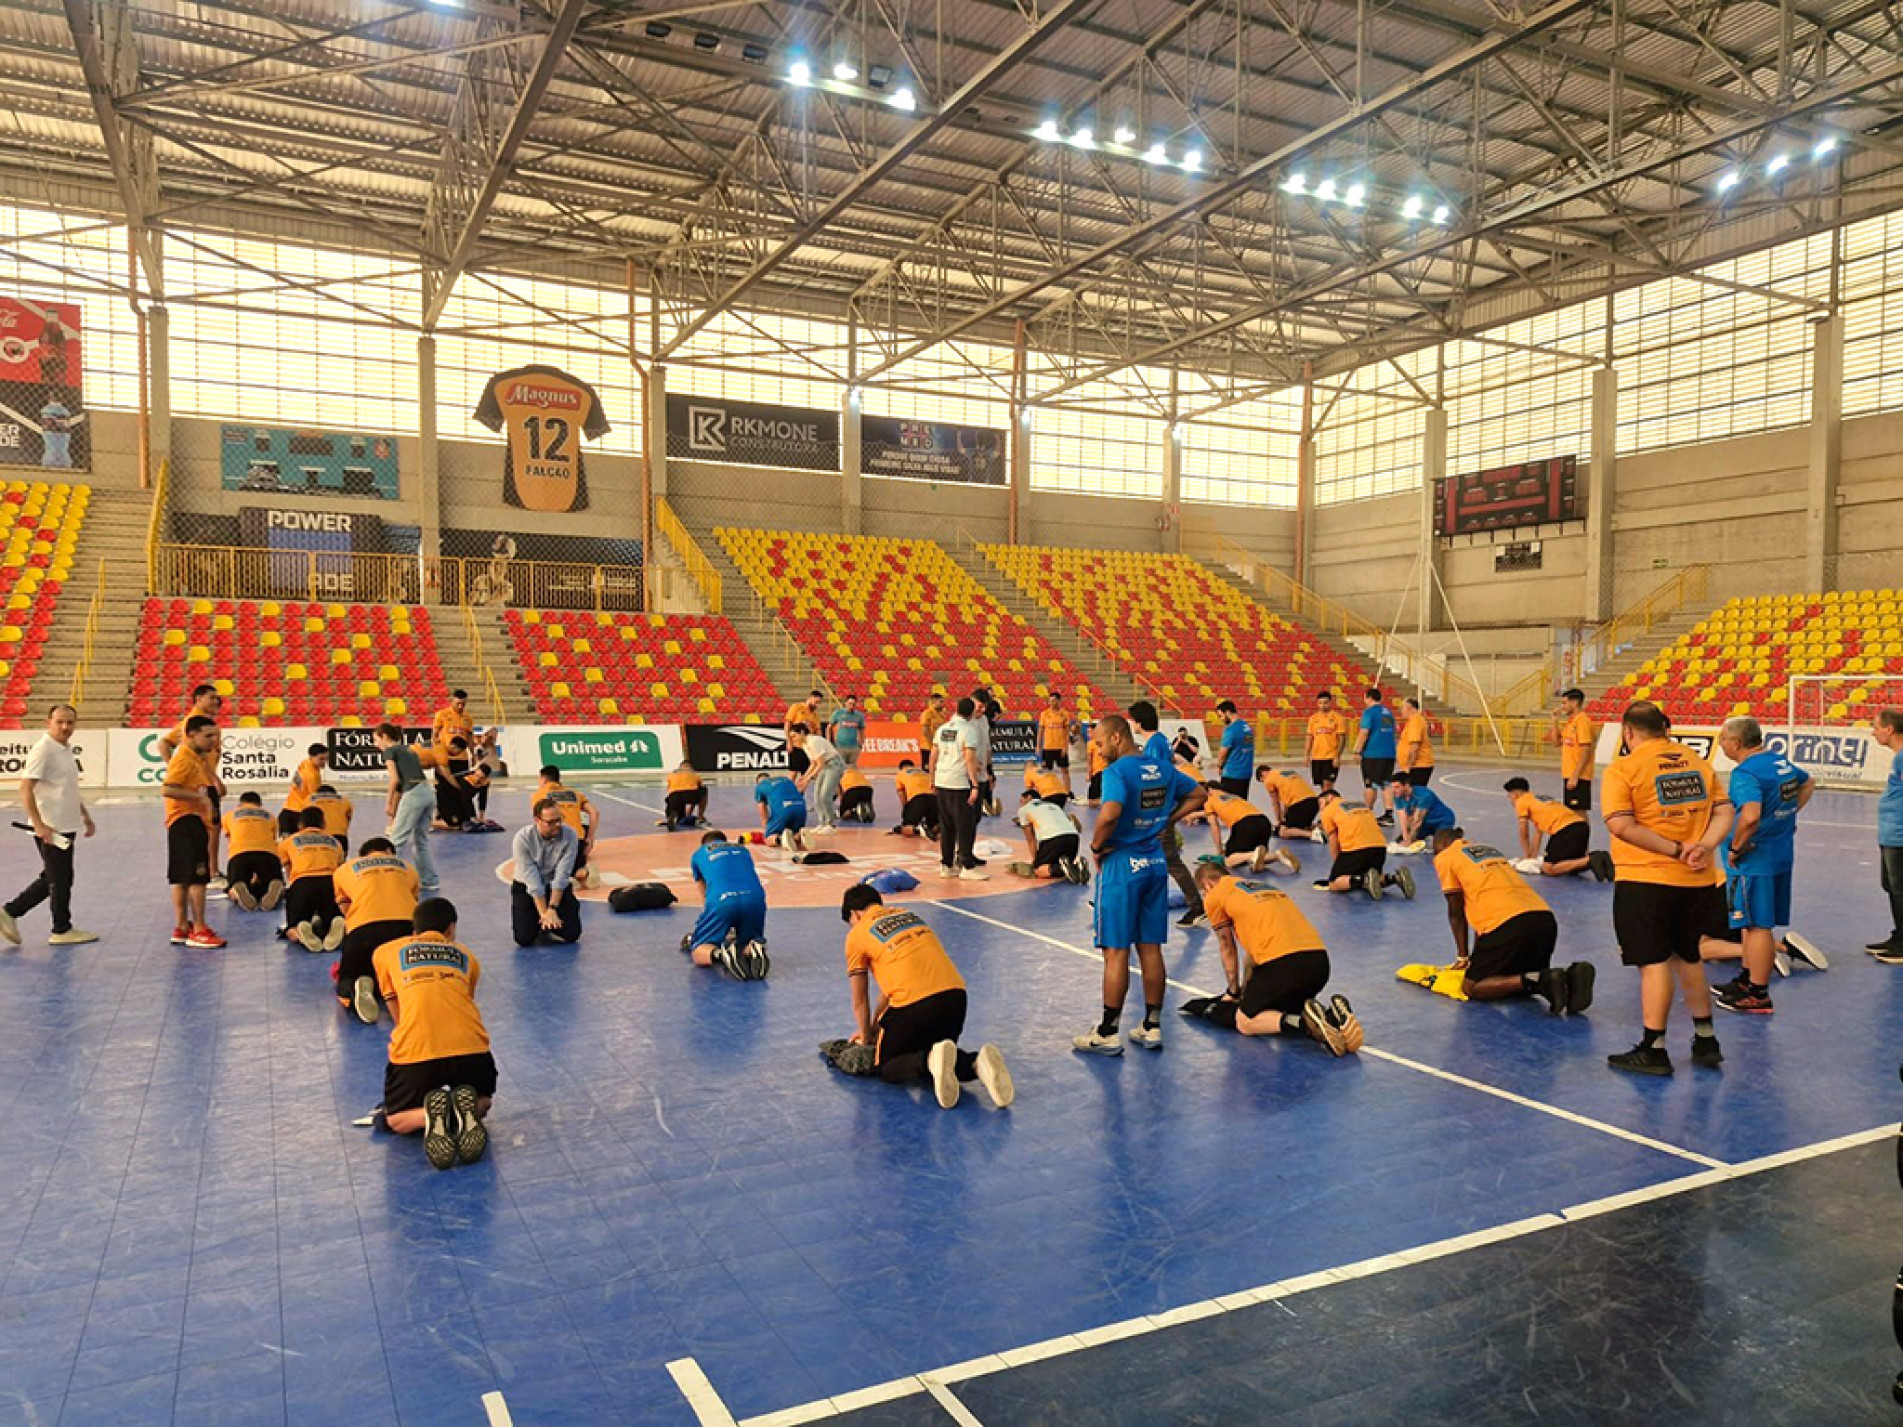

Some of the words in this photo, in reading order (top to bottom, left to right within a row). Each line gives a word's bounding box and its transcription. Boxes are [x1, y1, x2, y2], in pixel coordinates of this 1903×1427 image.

[507, 385, 577, 408] Magnus
[731, 416, 818, 441] RKMONE
[523, 416, 570, 461] 12
[267, 510, 351, 533] POWER
[222, 735, 296, 752] Colégio
[551, 740, 626, 756] Unimed
[221, 752, 276, 765] Santa
[717, 752, 789, 769] PENALT
[222, 766, 290, 780] Rosália
